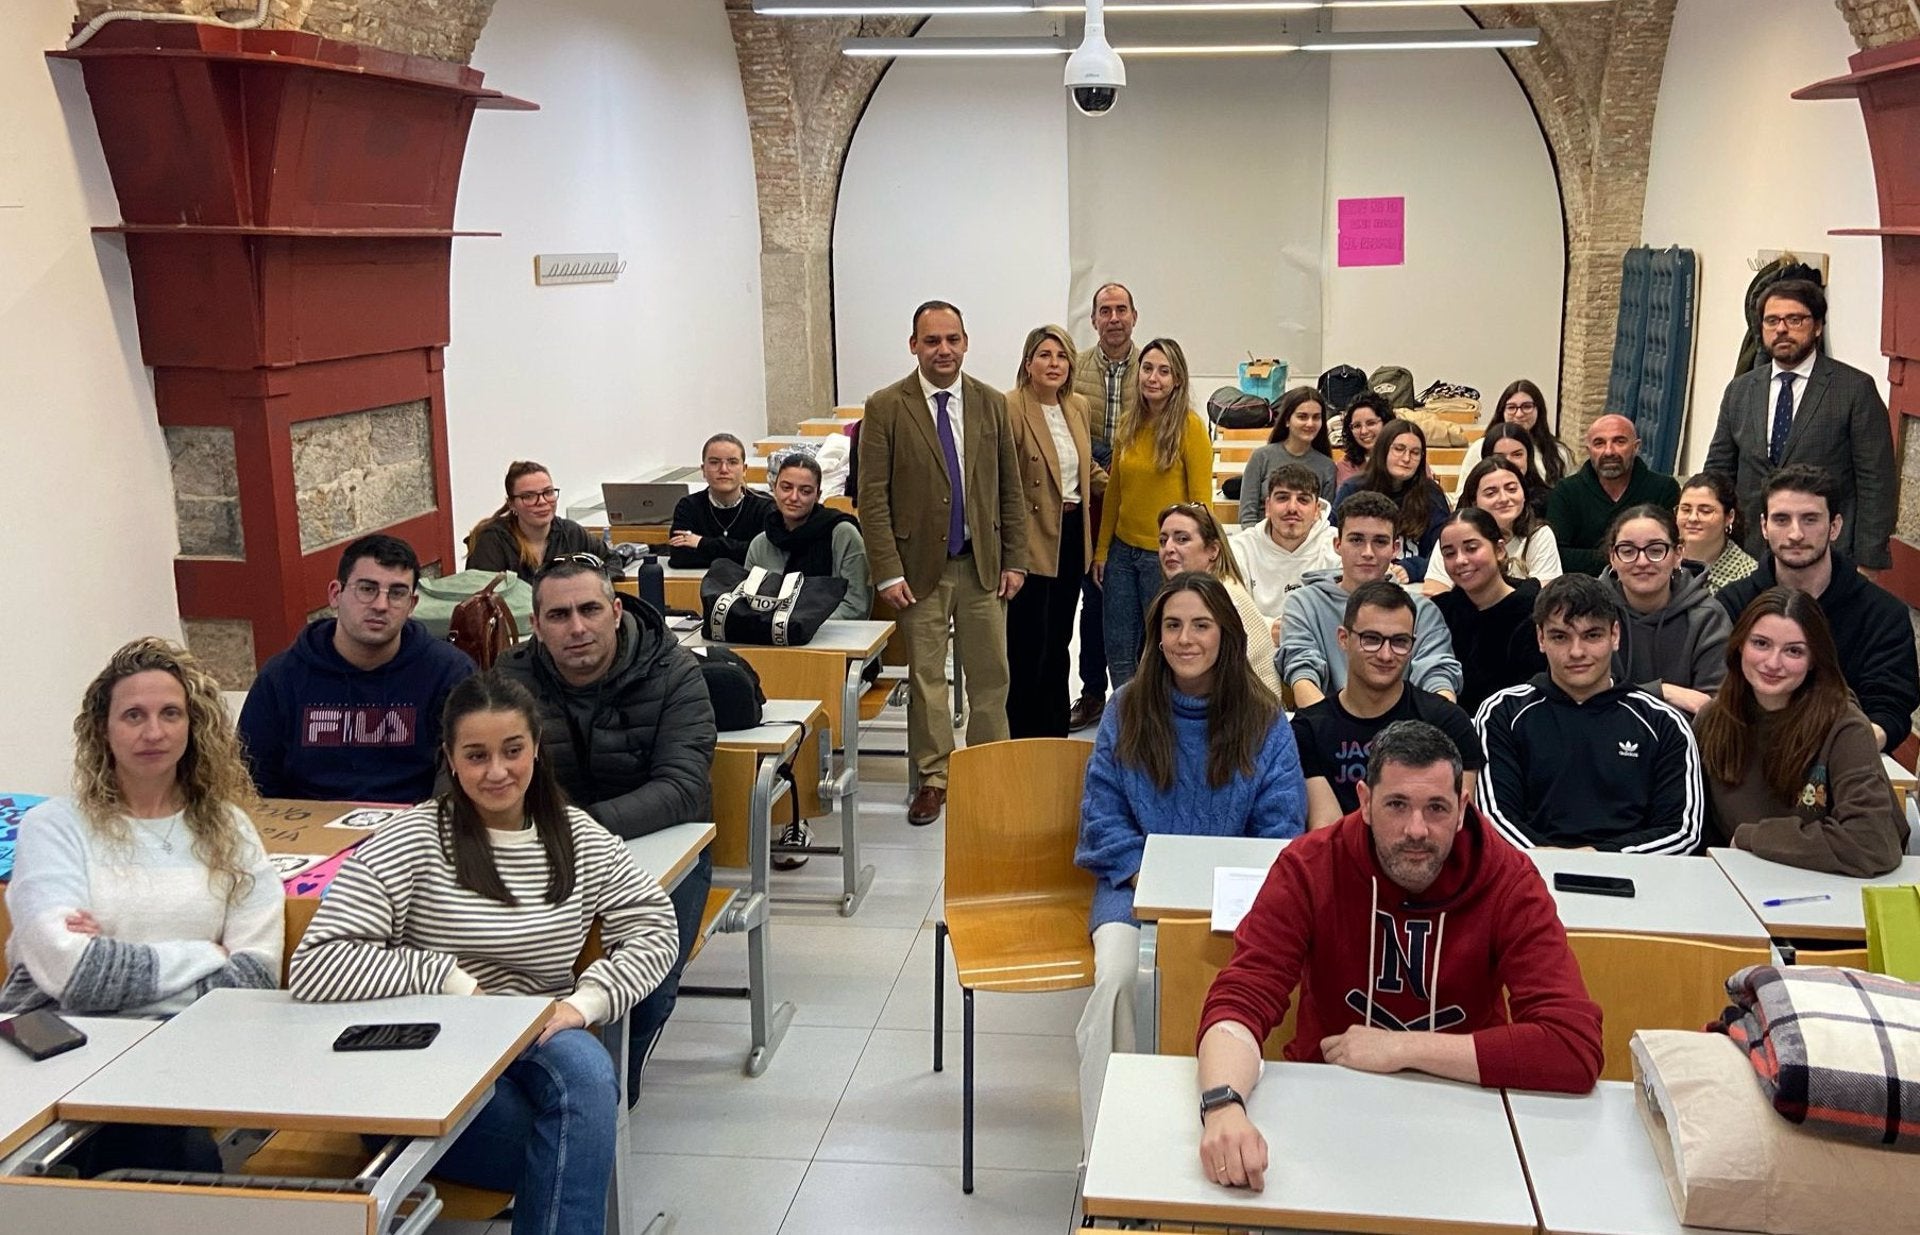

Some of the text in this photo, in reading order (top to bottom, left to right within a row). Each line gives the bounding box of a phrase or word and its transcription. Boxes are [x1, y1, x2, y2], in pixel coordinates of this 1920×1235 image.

[713, 597, 731, 626] LOLA
[775, 621, 785, 645] OLA
[308, 710, 408, 743] FILA
[1335, 740, 1374, 759] JAC
[1334, 763, 1367, 784] JO
[1376, 909, 1432, 1000] N
